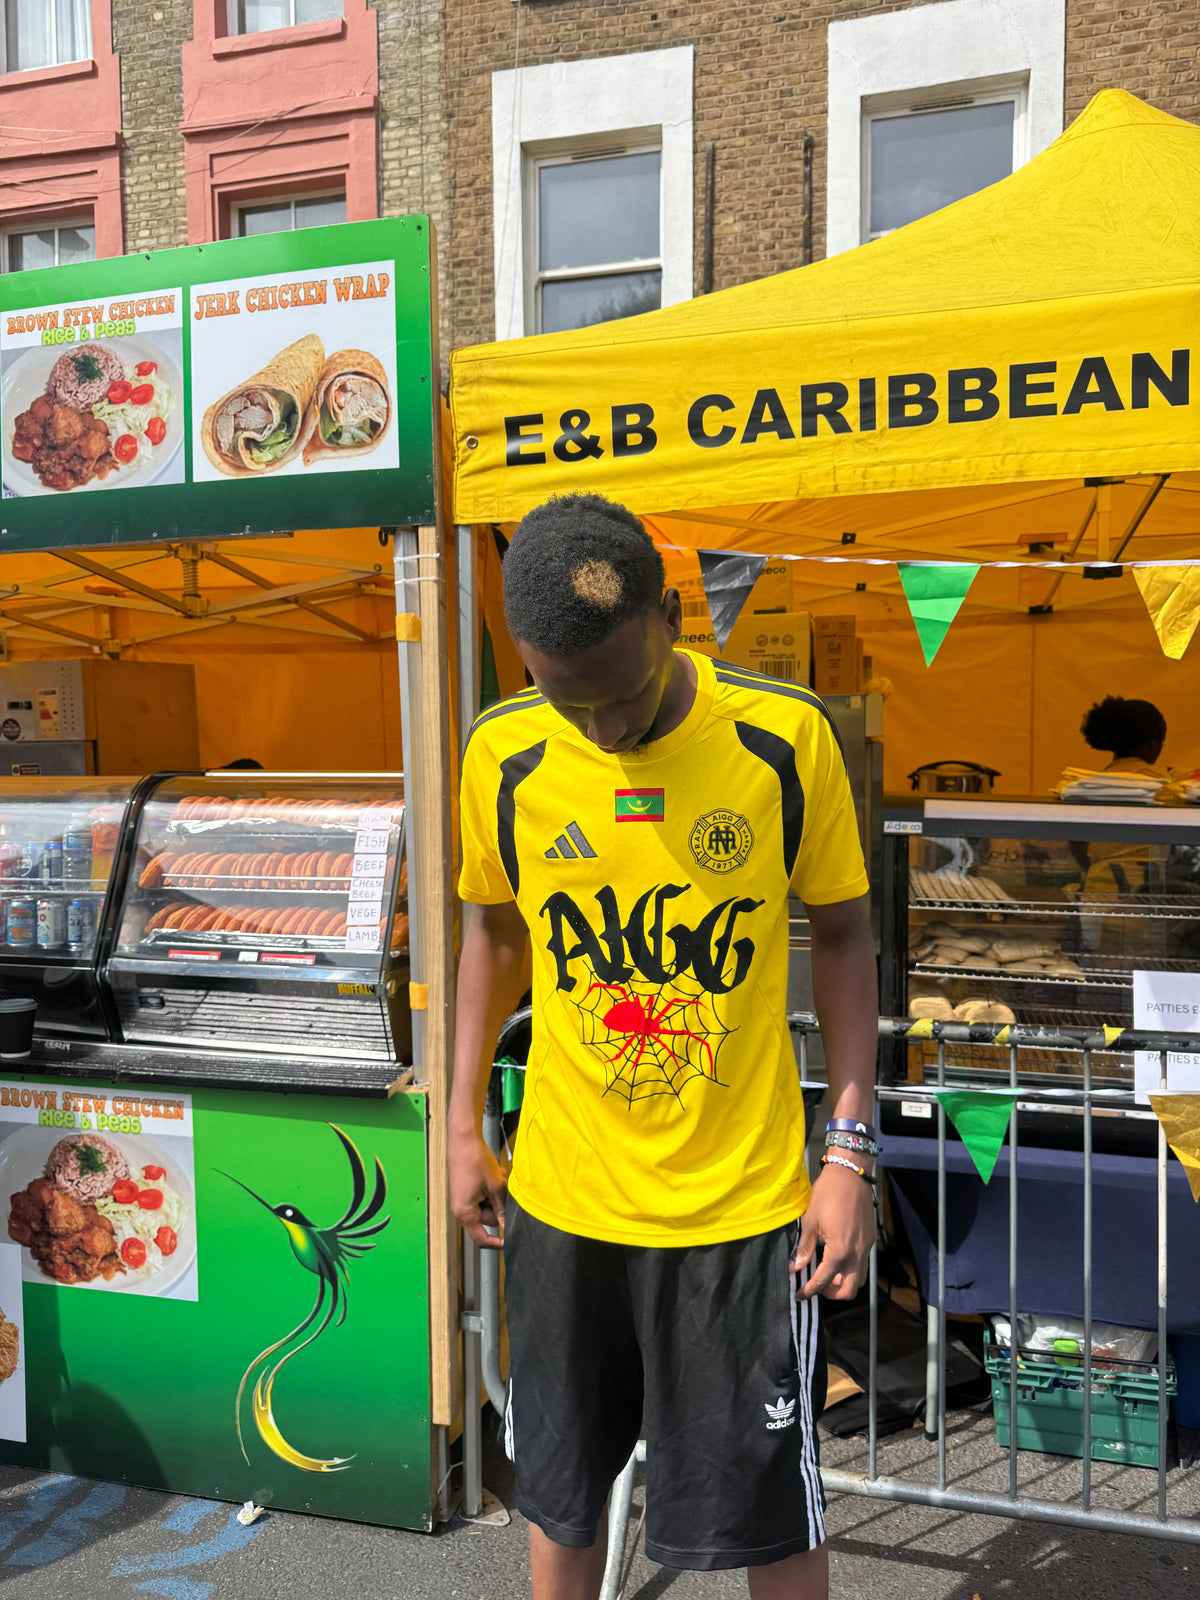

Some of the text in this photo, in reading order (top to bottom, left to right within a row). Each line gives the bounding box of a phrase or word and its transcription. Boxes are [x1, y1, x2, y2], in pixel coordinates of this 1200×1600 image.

[195, 273, 390, 320] JERK CHICKEN WRAP
[7, 295, 176, 335] BROWN STEW CHICKEN
[80, 325, 90, 341] &
[504, 349, 1190, 467] E&B CARIBBEAN
[357, 836, 386, 848] FISH
[694, 828, 702, 856] TRAP
[355, 860, 385, 872] BEEF
[712, 861, 733, 869] 1977
[350, 907, 377, 918] VEGE
[349, 931, 378, 941] LAMB
[1146, 1003, 1189, 1014] PATTIES
[1148, 1053, 1190, 1064] PATIES
[1, 1088, 184, 1120] BROWN STEW CHICKEN
[81, 1112, 92, 1130] &
